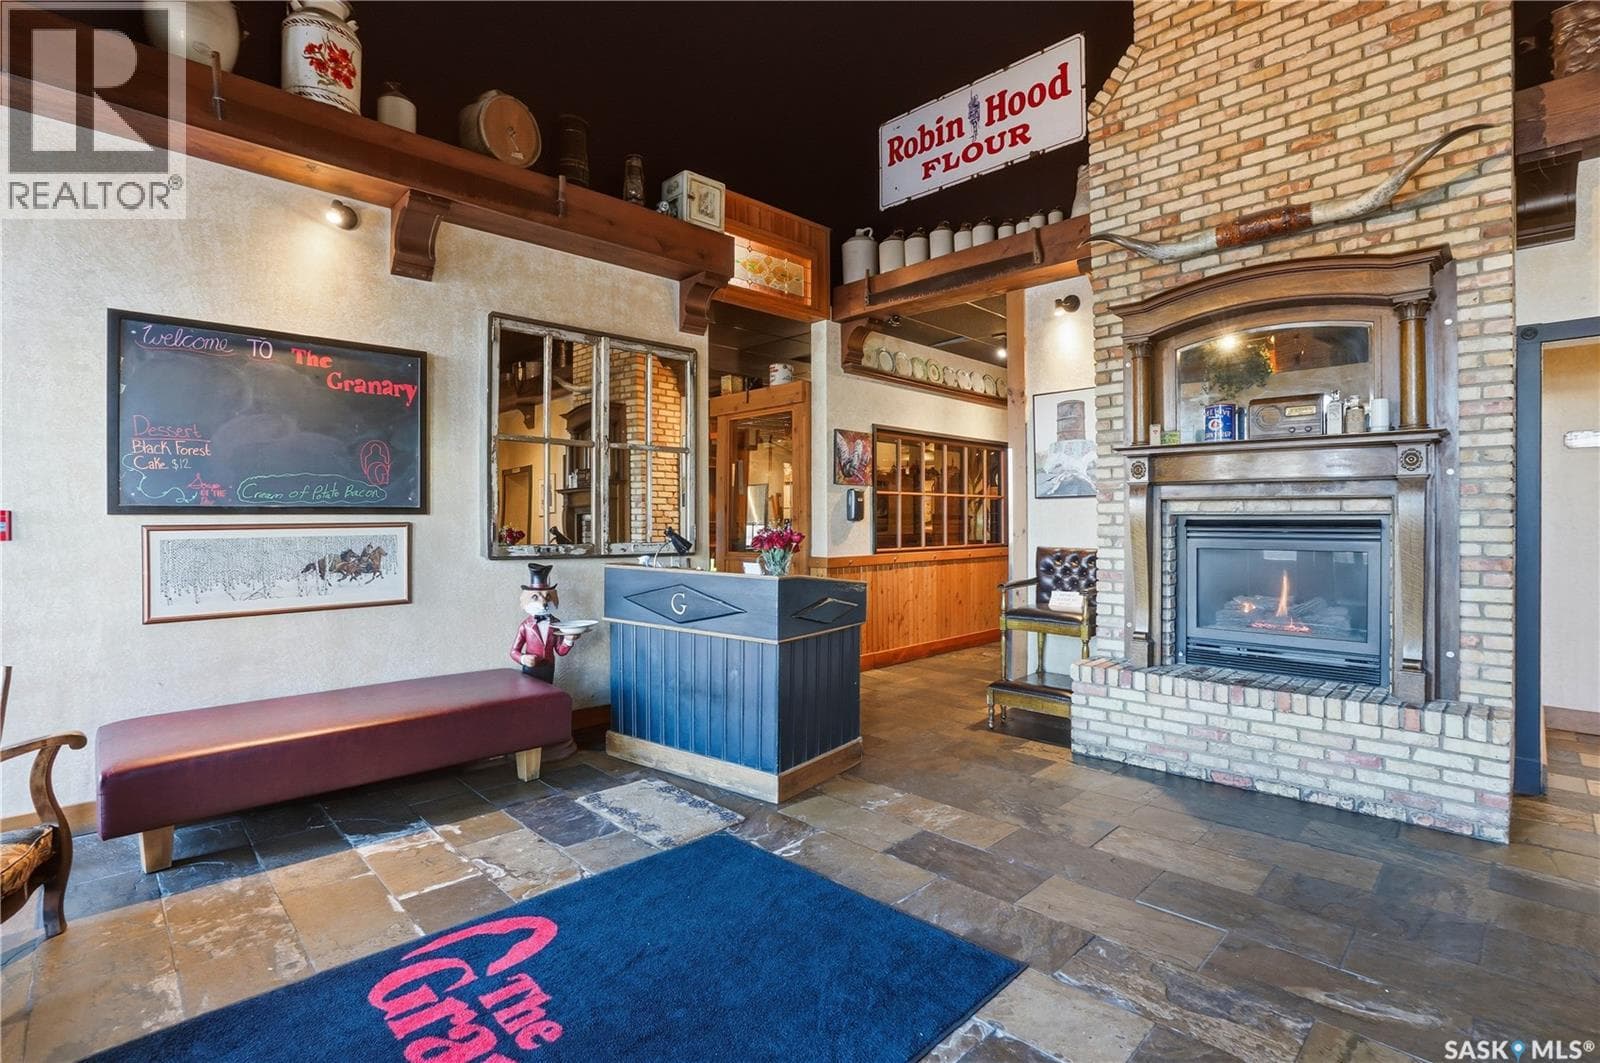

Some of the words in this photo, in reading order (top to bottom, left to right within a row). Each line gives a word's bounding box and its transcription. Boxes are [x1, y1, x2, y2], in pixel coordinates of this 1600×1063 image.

[887, 115, 965, 167] Robin
[984, 61, 1072, 127] Hood
[921, 123, 1032, 180] FLOUR
[290, 346, 334, 369] The
[326, 371, 418, 407] Granary
[133, 414, 202, 438] Dessert
[132, 439, 172, 455] Black
[175, 440, 212, 456] Forest
[133, 455, 169, 470] Cake
[172, 458, 192, 472] $12
[242, 483, 284, 500] Cream
[288, 485, 310, 499] of
[344, 485, 381, 499] Bacon
[671, 592, 688, 615] G
[367, 957, 519, 1063] Gra
[478, 972, 564, 1051] The
